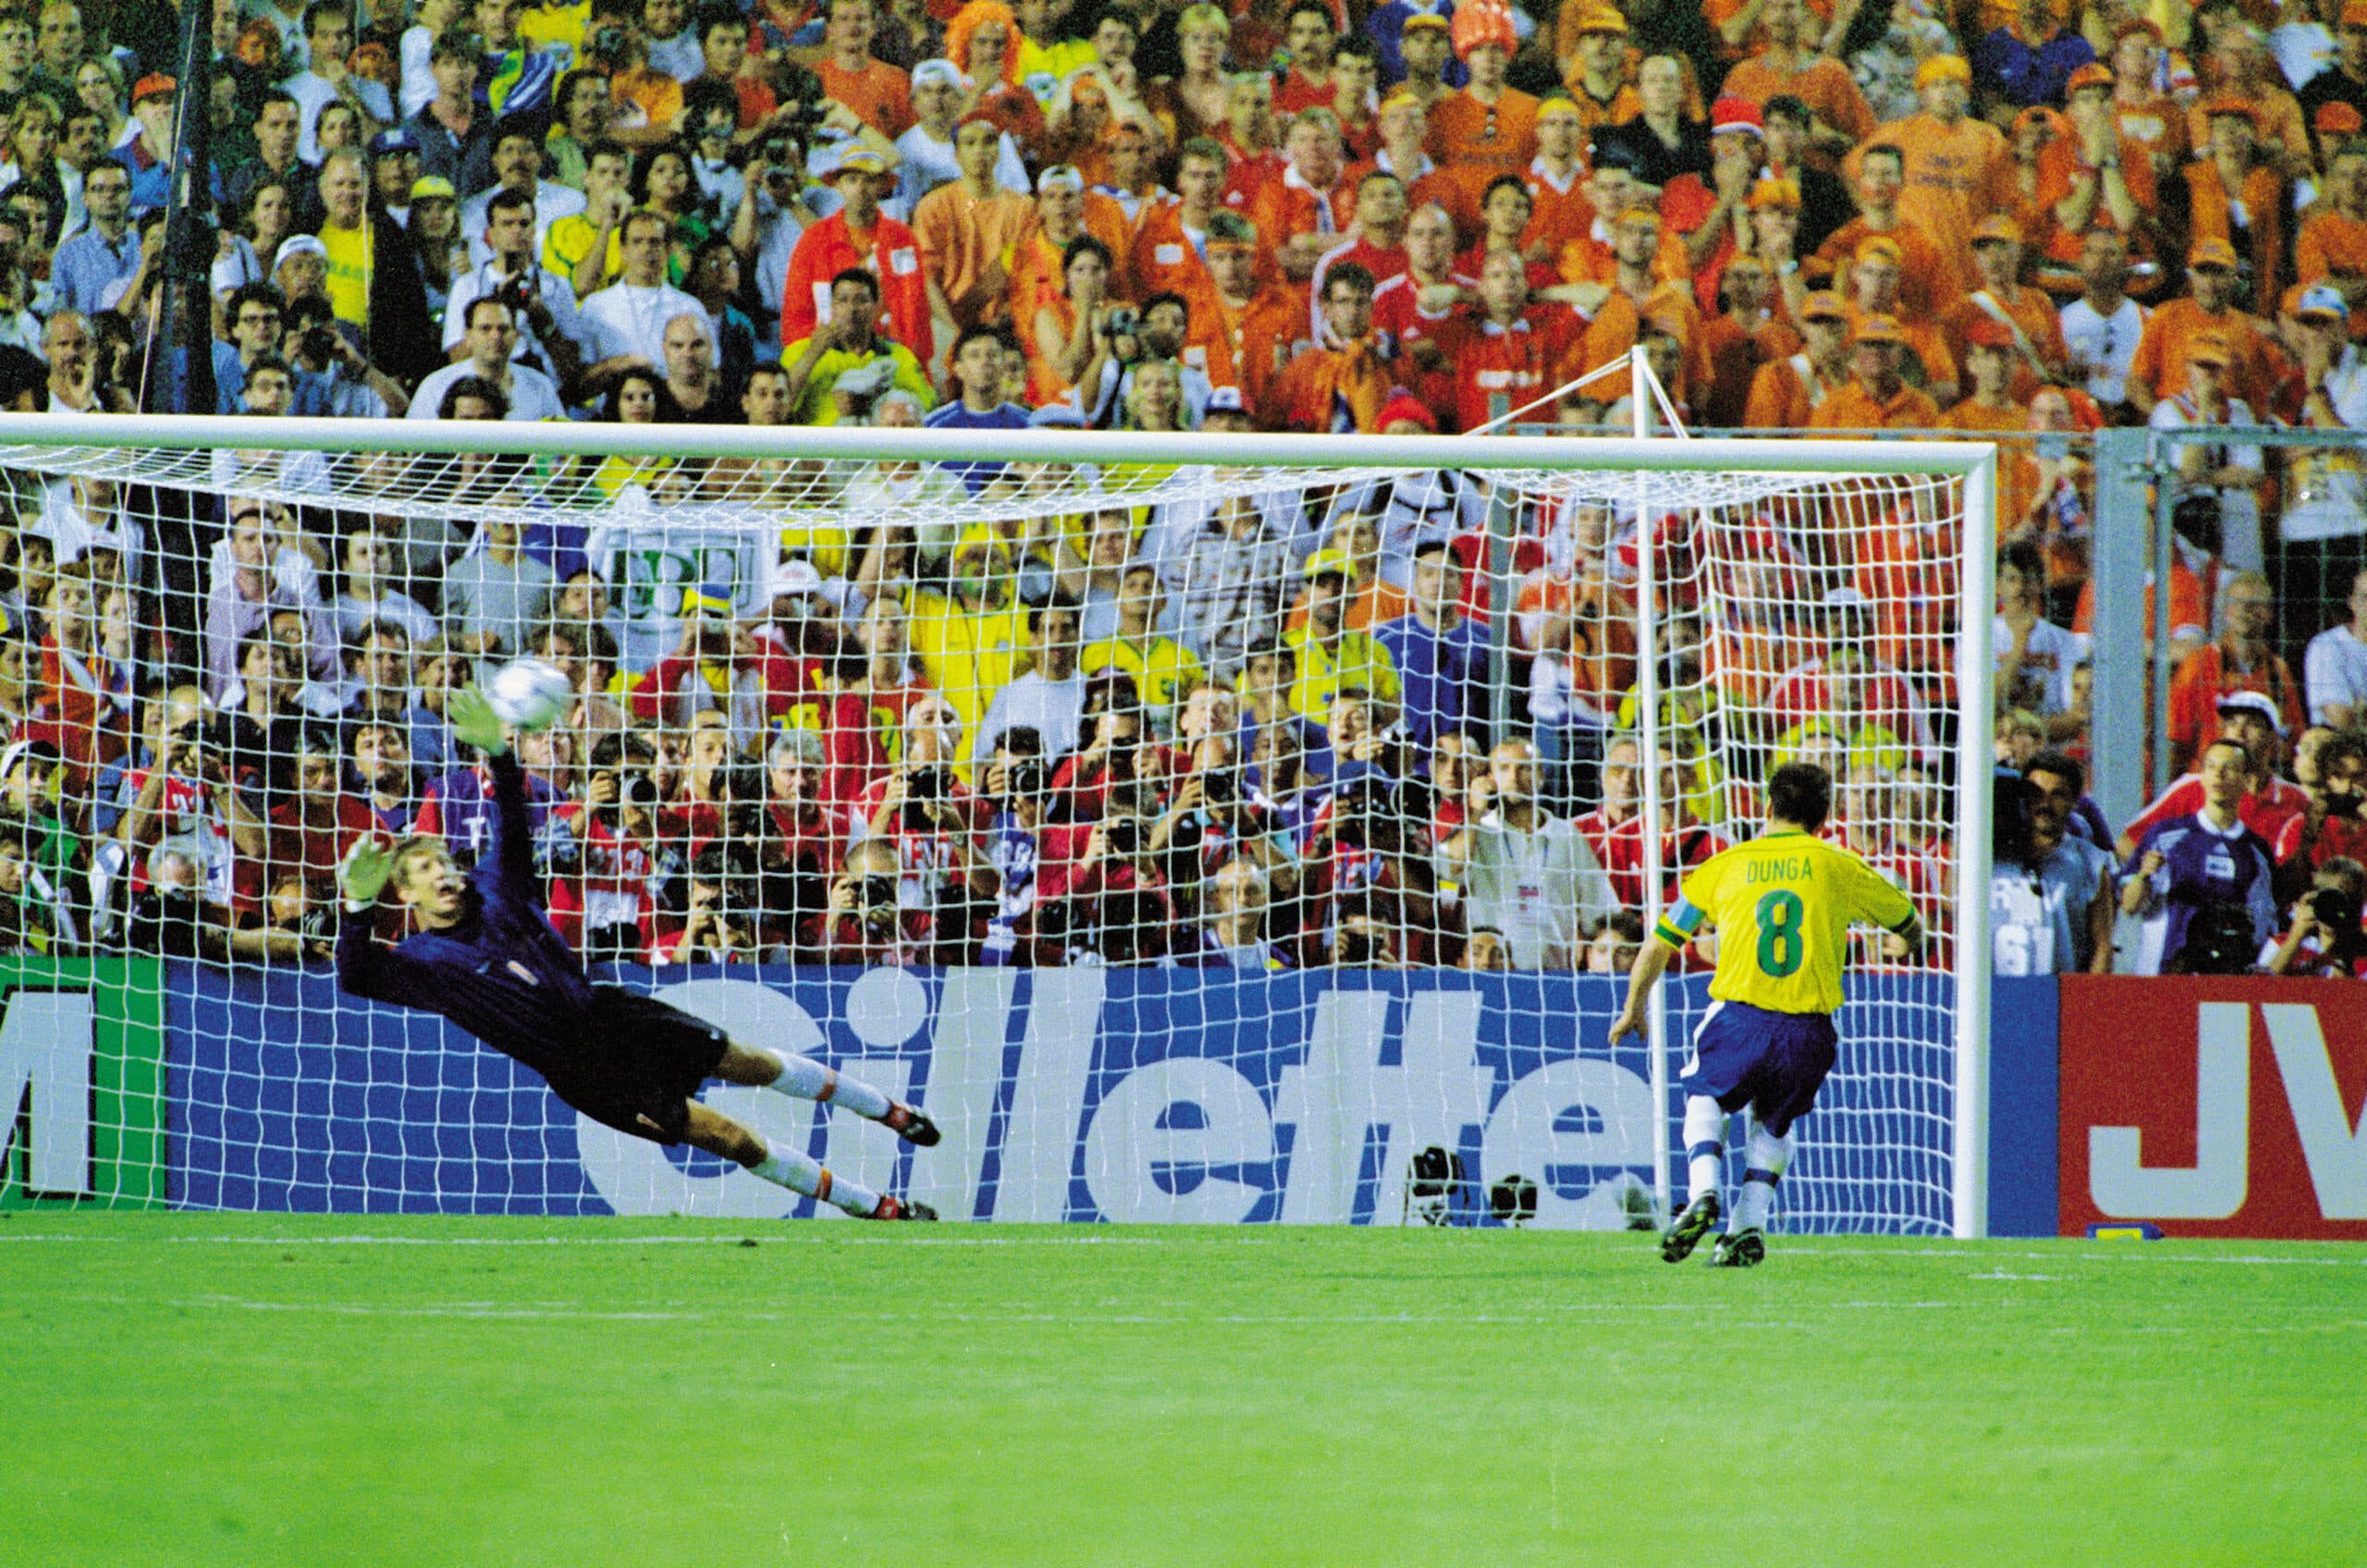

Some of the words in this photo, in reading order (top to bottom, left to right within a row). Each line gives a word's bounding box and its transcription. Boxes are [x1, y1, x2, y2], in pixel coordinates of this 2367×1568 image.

[1747, 856, 1813, 884] DUNGA
[1755, 888, 1804, 978] 8
[575, 965, 1661, 1230] Gillette
[2088, 1001, 2367, 1219] JV
